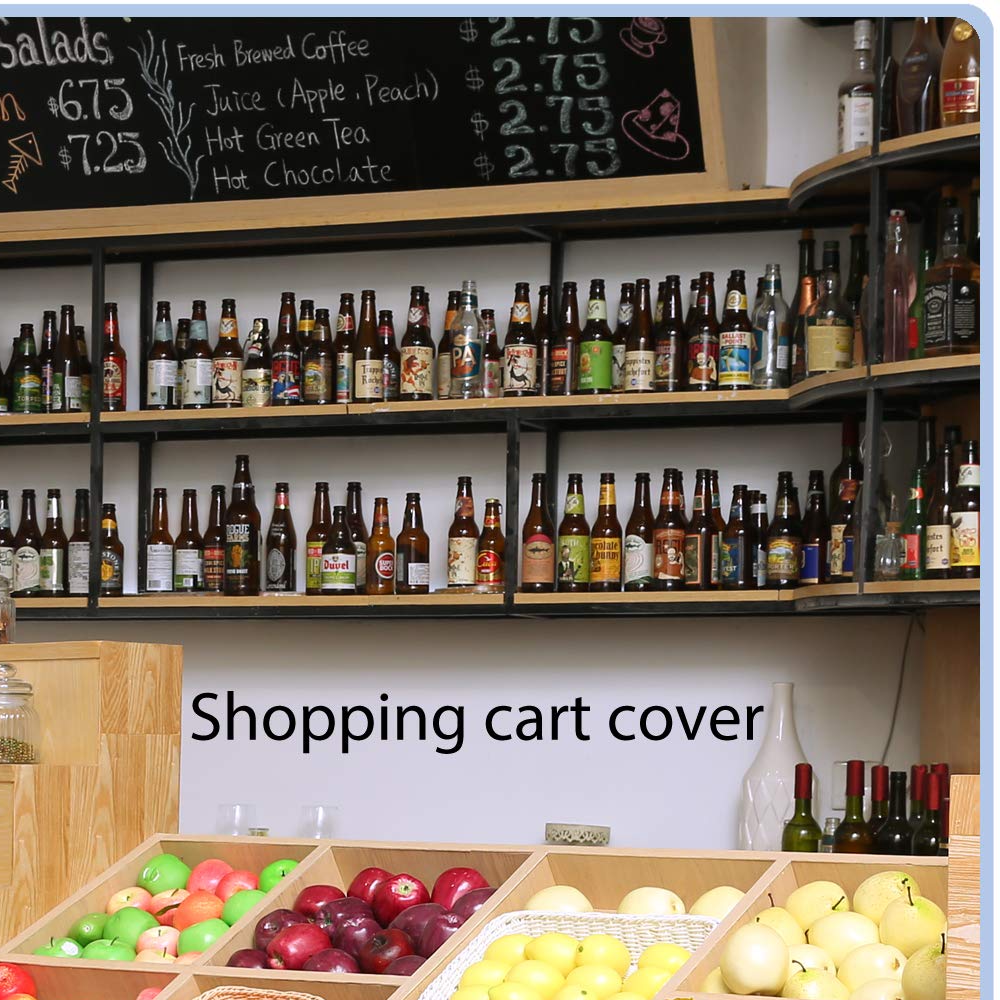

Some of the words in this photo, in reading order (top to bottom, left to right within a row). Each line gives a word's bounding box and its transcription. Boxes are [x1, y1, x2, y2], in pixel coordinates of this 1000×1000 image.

[177, 43, 226, 71] Fresh
[234, 34, 296, 67] Brewed
[301, 30, 370, 64] Coffee
[204, 84, 266, 115] Juice
[205, 126, 244, 155] Hot
[256, 122, 321, 150] Green
[322, 118, 370, 149] Tea
[213, 165, 250, 194] Hot
[264, 156, 394, 187] Chocolate
[324, 559, 349, 570] Duvel
